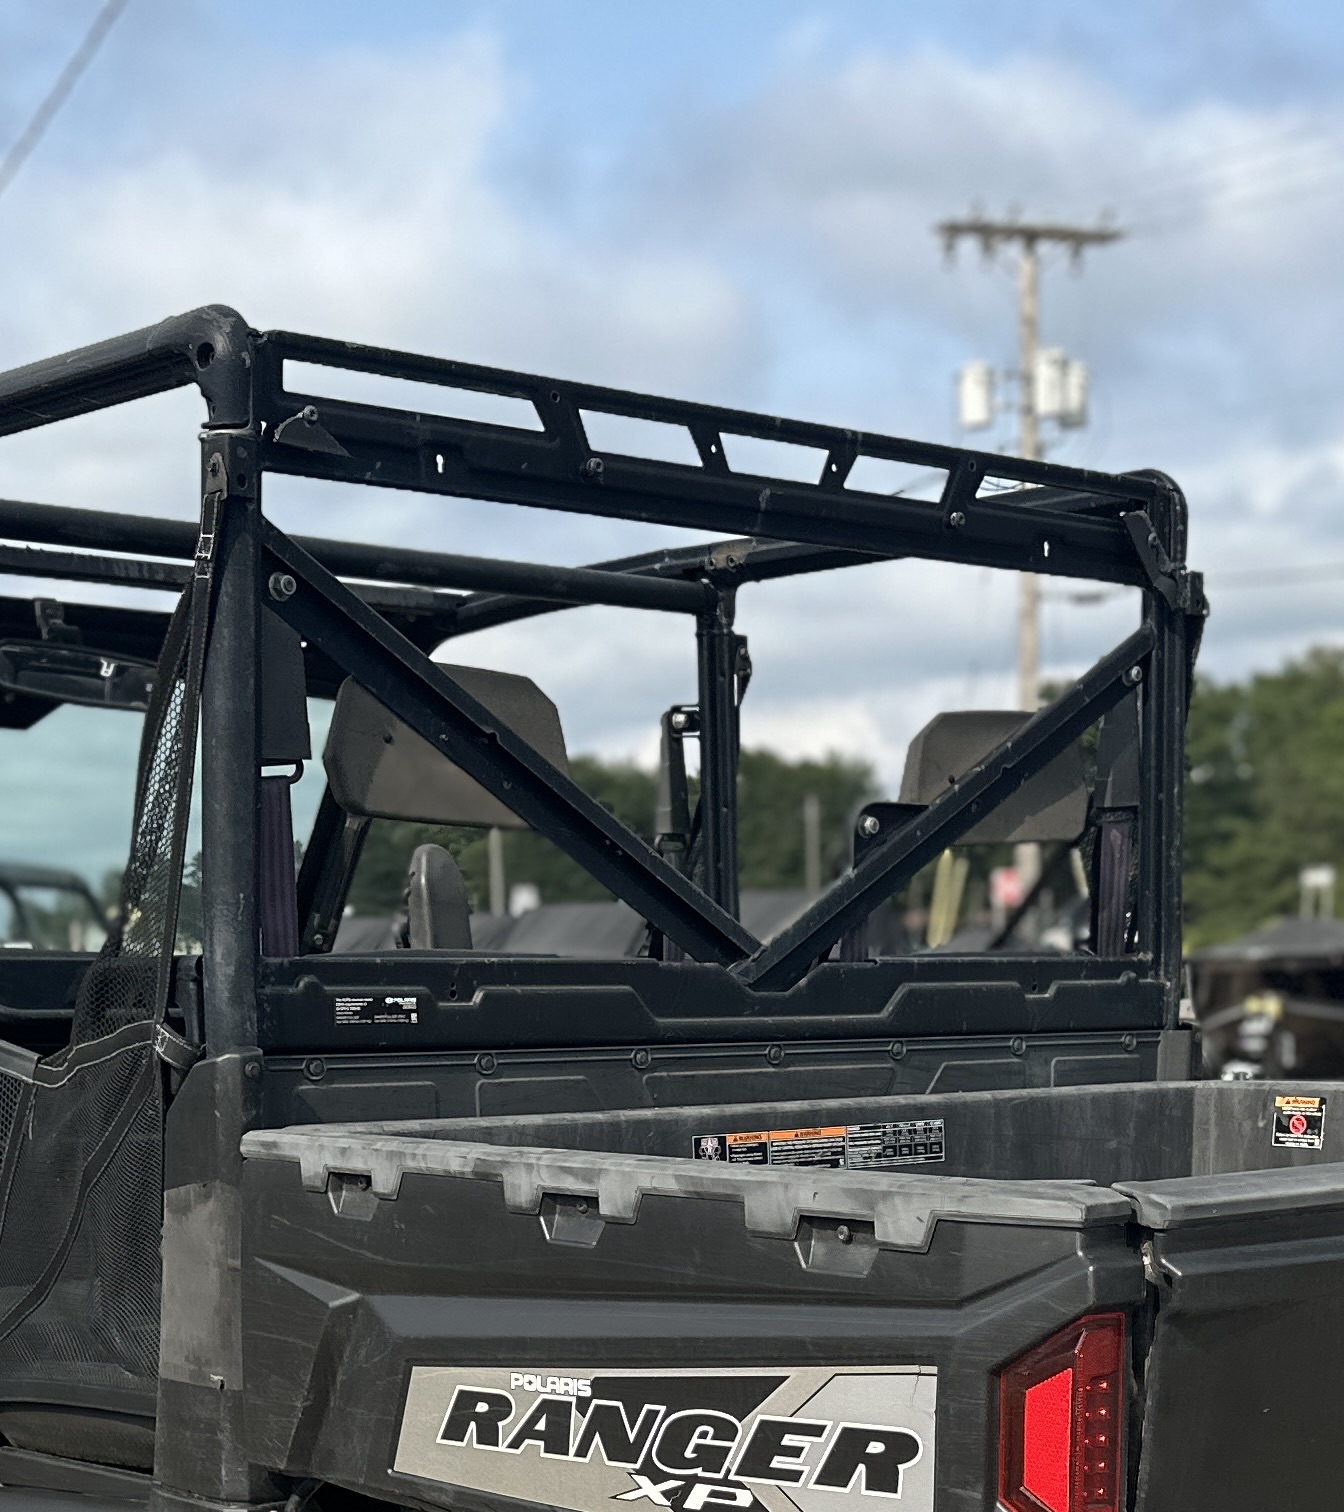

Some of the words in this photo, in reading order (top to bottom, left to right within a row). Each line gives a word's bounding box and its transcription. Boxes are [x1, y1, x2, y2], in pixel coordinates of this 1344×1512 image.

[510, 1371, 592, 1397] POLARIS
[436, 1384, 923, 1499] RANGER
[610, 1472, 754, 1510] XP
